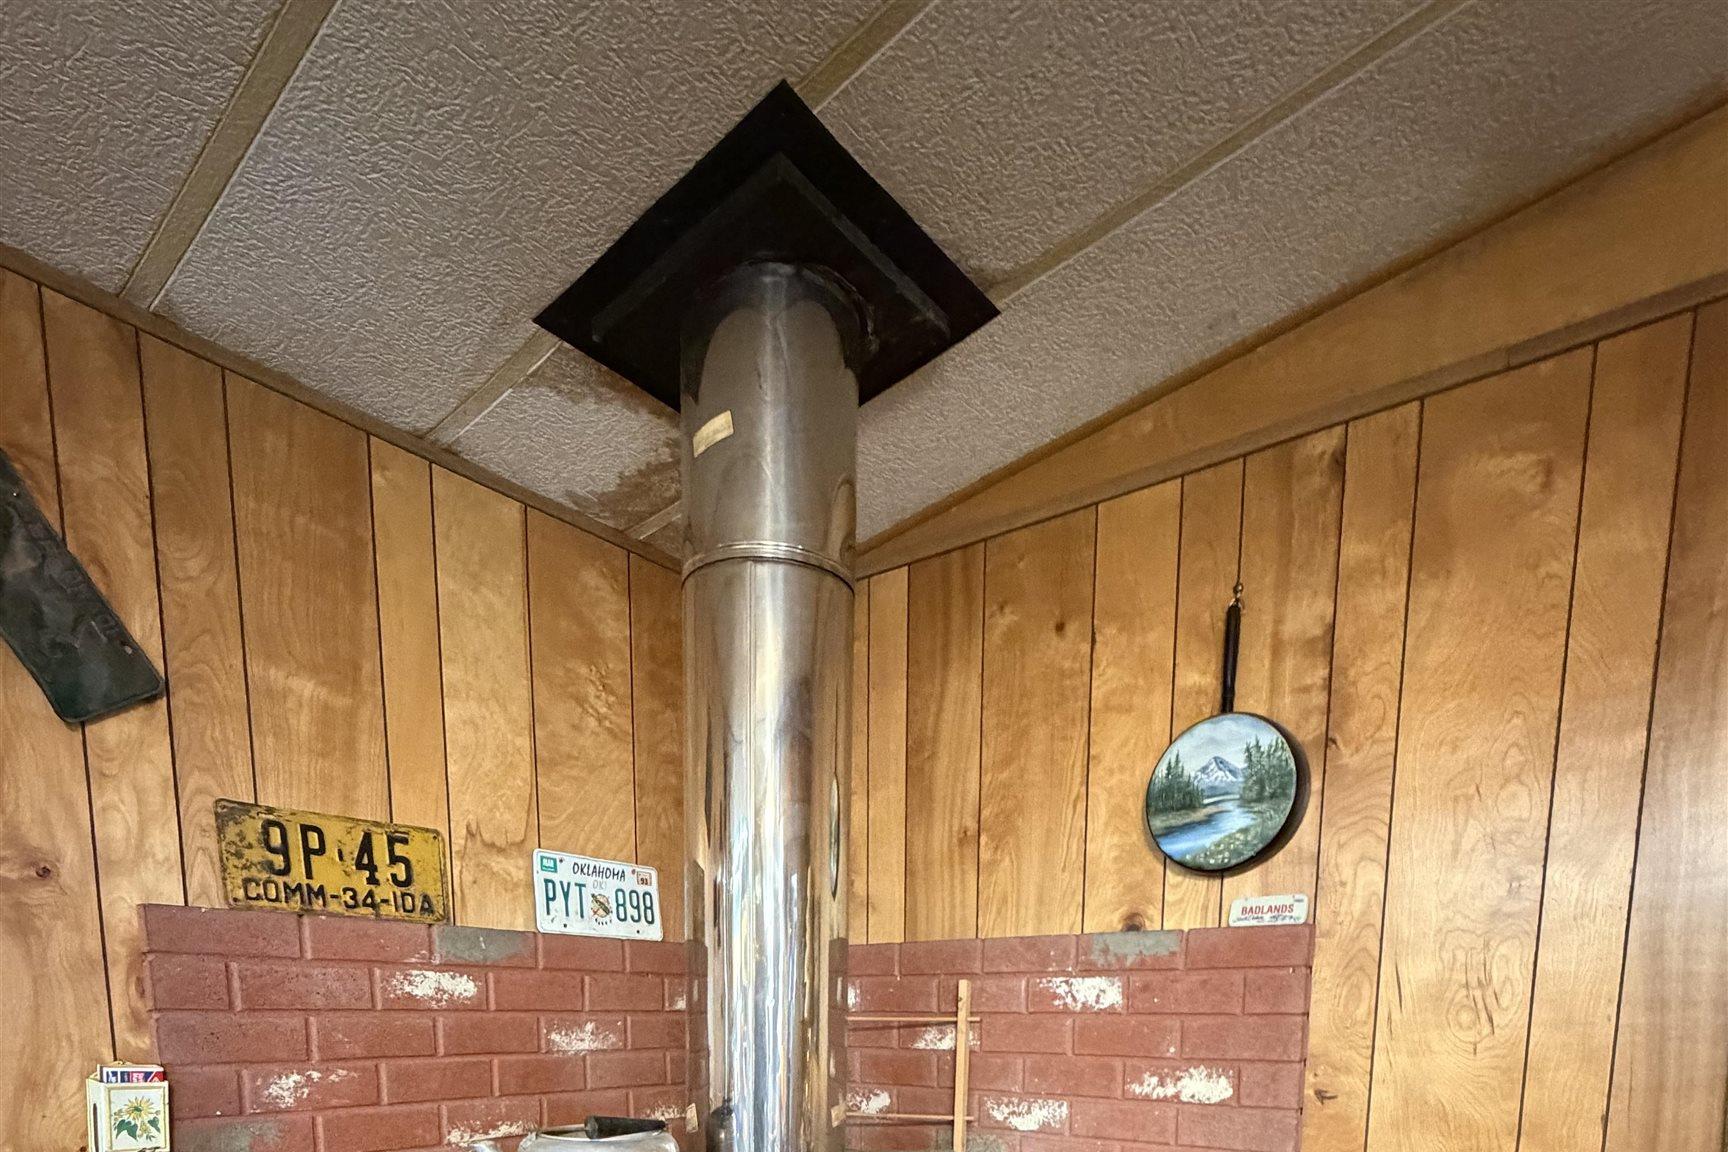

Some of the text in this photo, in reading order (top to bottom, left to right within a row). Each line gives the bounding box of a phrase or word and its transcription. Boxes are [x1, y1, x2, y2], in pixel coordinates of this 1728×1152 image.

[261, 818, 415, 888] 9P 45
[572, 861, 626, 882] OKLAHOMA
[543, 877, 655, 925] PYT 898
[1241, 904, 1294, 916] BADLANDS
